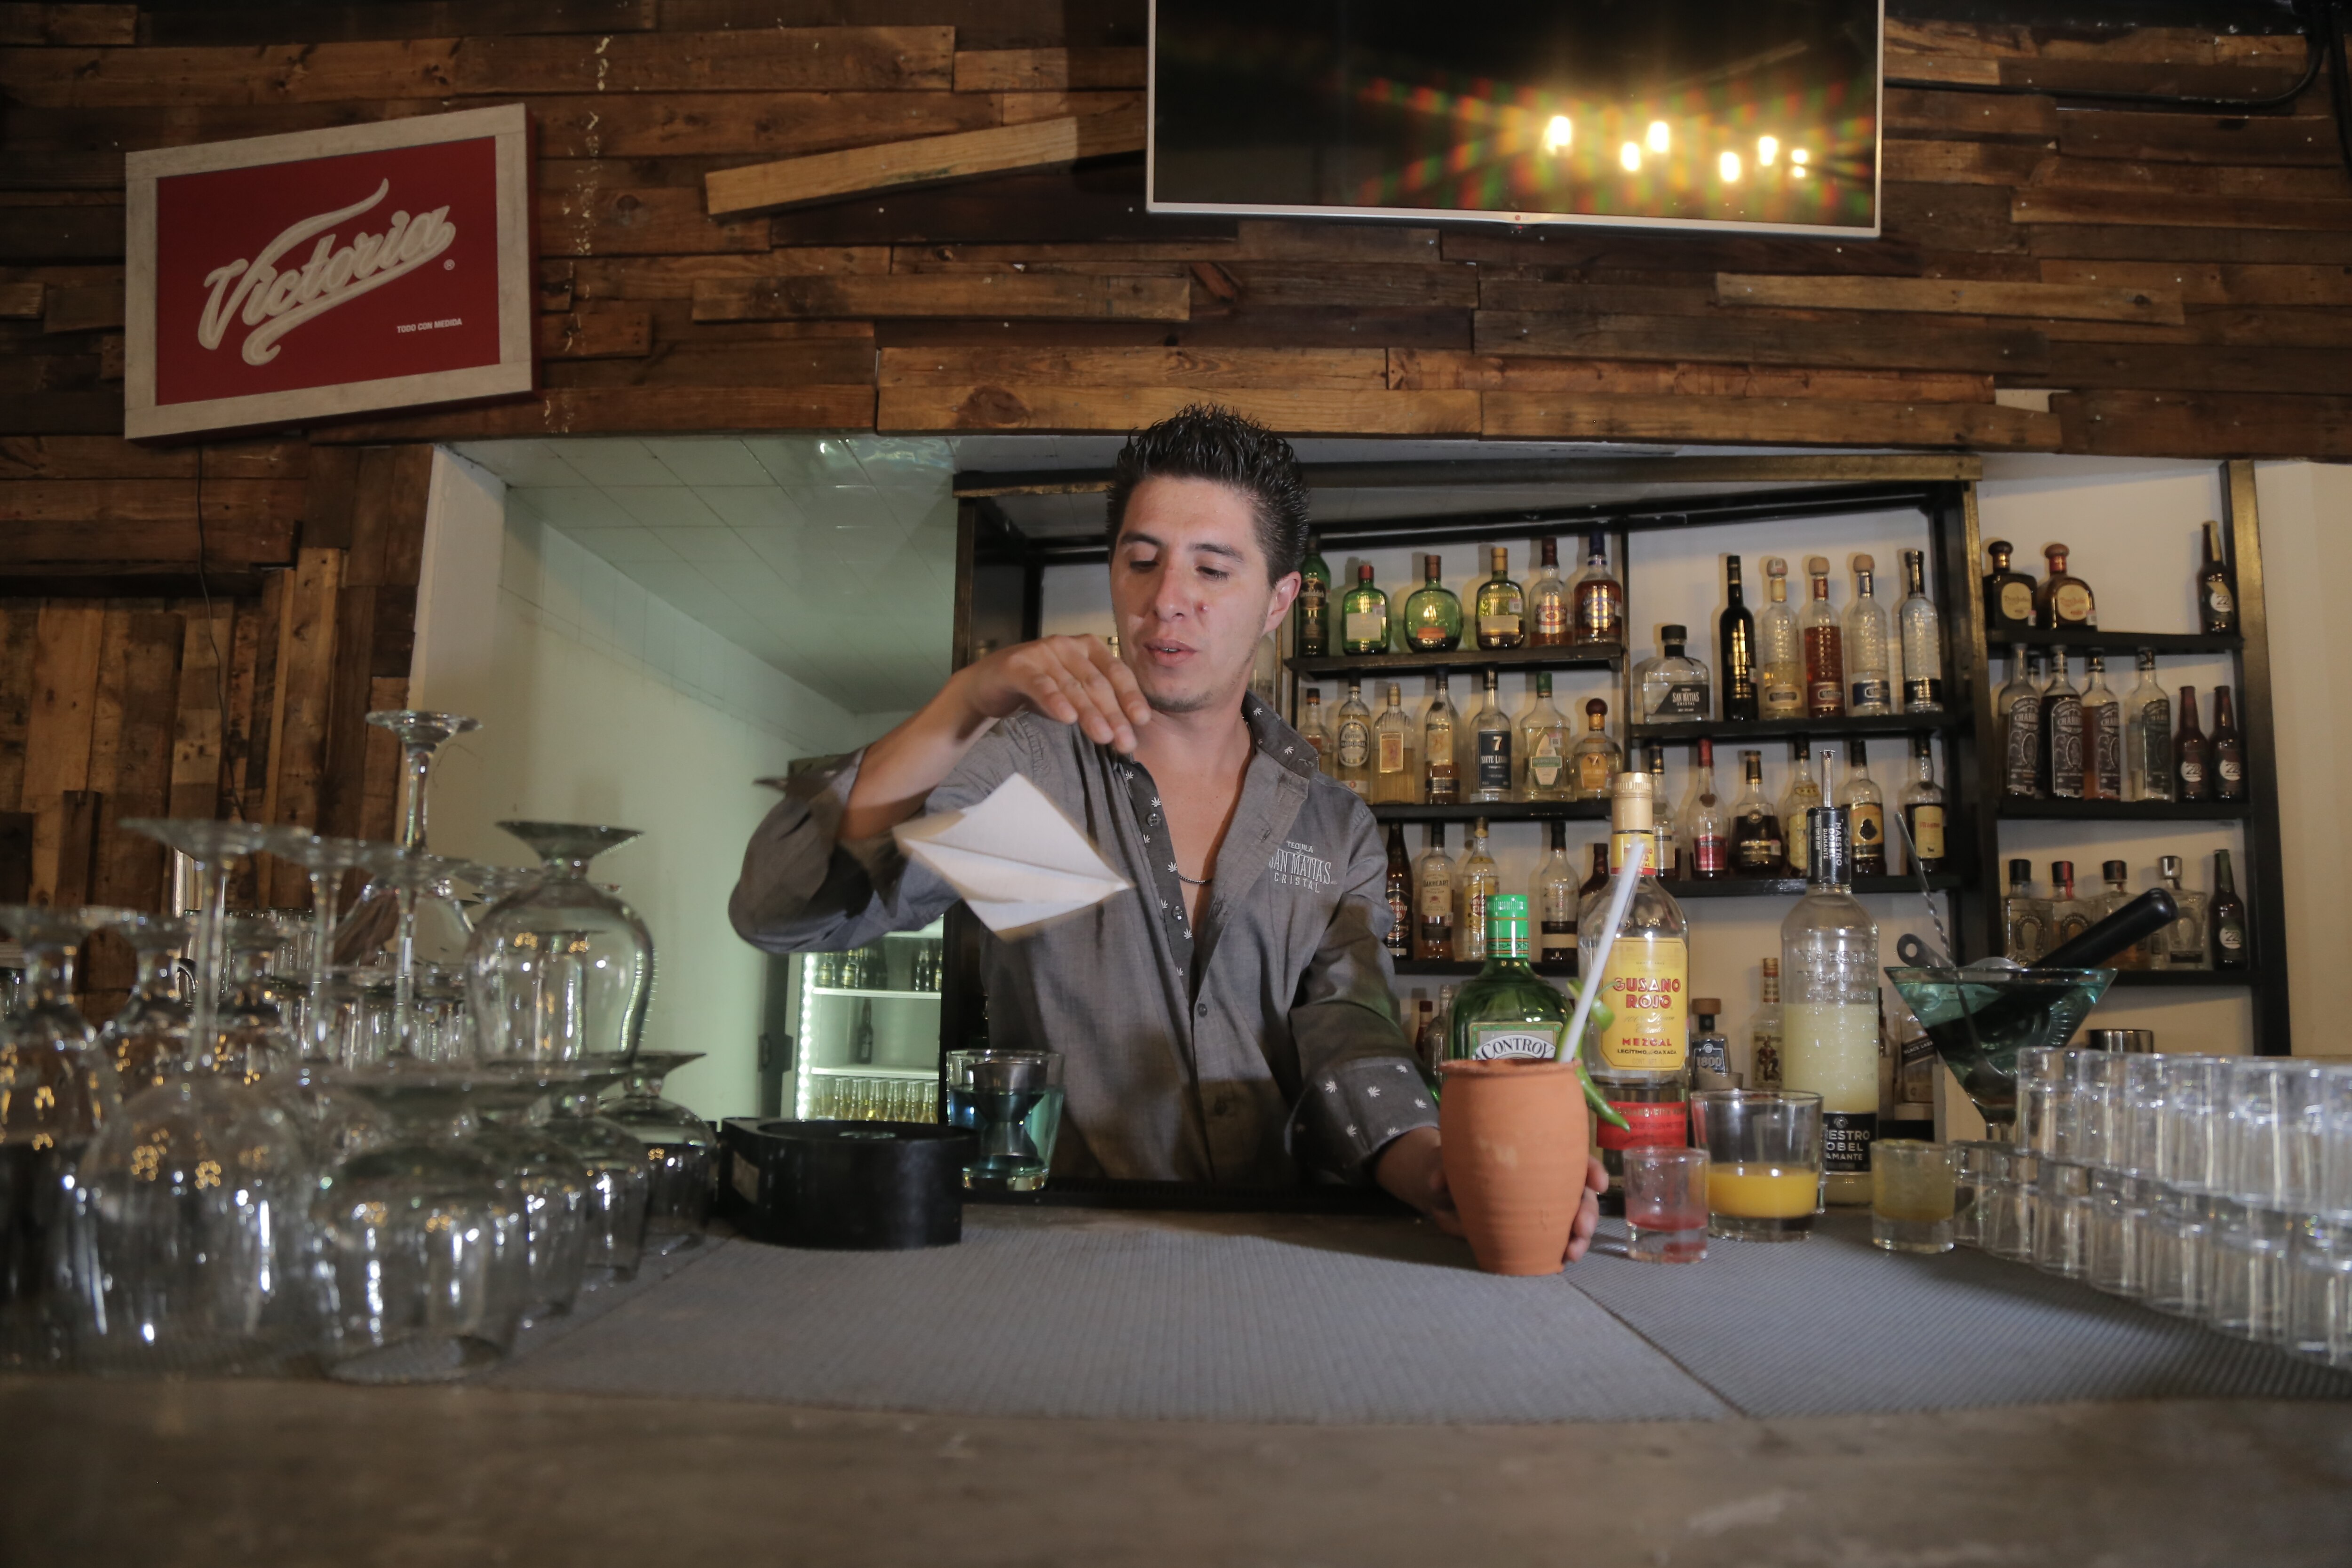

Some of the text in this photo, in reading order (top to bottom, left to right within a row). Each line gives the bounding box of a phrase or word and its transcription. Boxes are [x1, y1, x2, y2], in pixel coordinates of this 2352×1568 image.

[198, 178, 456, 366] Victoria
[397, 318, 462, 333] TODO CON MEDIDA
[1673, 692, 1682, 702] SAN
[1493, 736, 1502, 751] 7
[1287, 841, 1313, 853] TEQUILA
[1291, 853, 1332, 884] MATIAS
[1274, 872, 1320, 893] CRISTAL
[1423, 879, 1449, 888] OAKHEART
[1613, 978, 1681, 992] GUSANO
[1626, 994, 1672, 1009] ROJO
[1481, 1038, 1555, 1059] CONTROY
[1622, 1038, 1672, 1046] MEZCAL
[1696, 1056, 1722, 1067] 1800
[1826, 1130, 1870, 1140] ESTRO
[1826, 1142, 1863, 1151] OBEL
